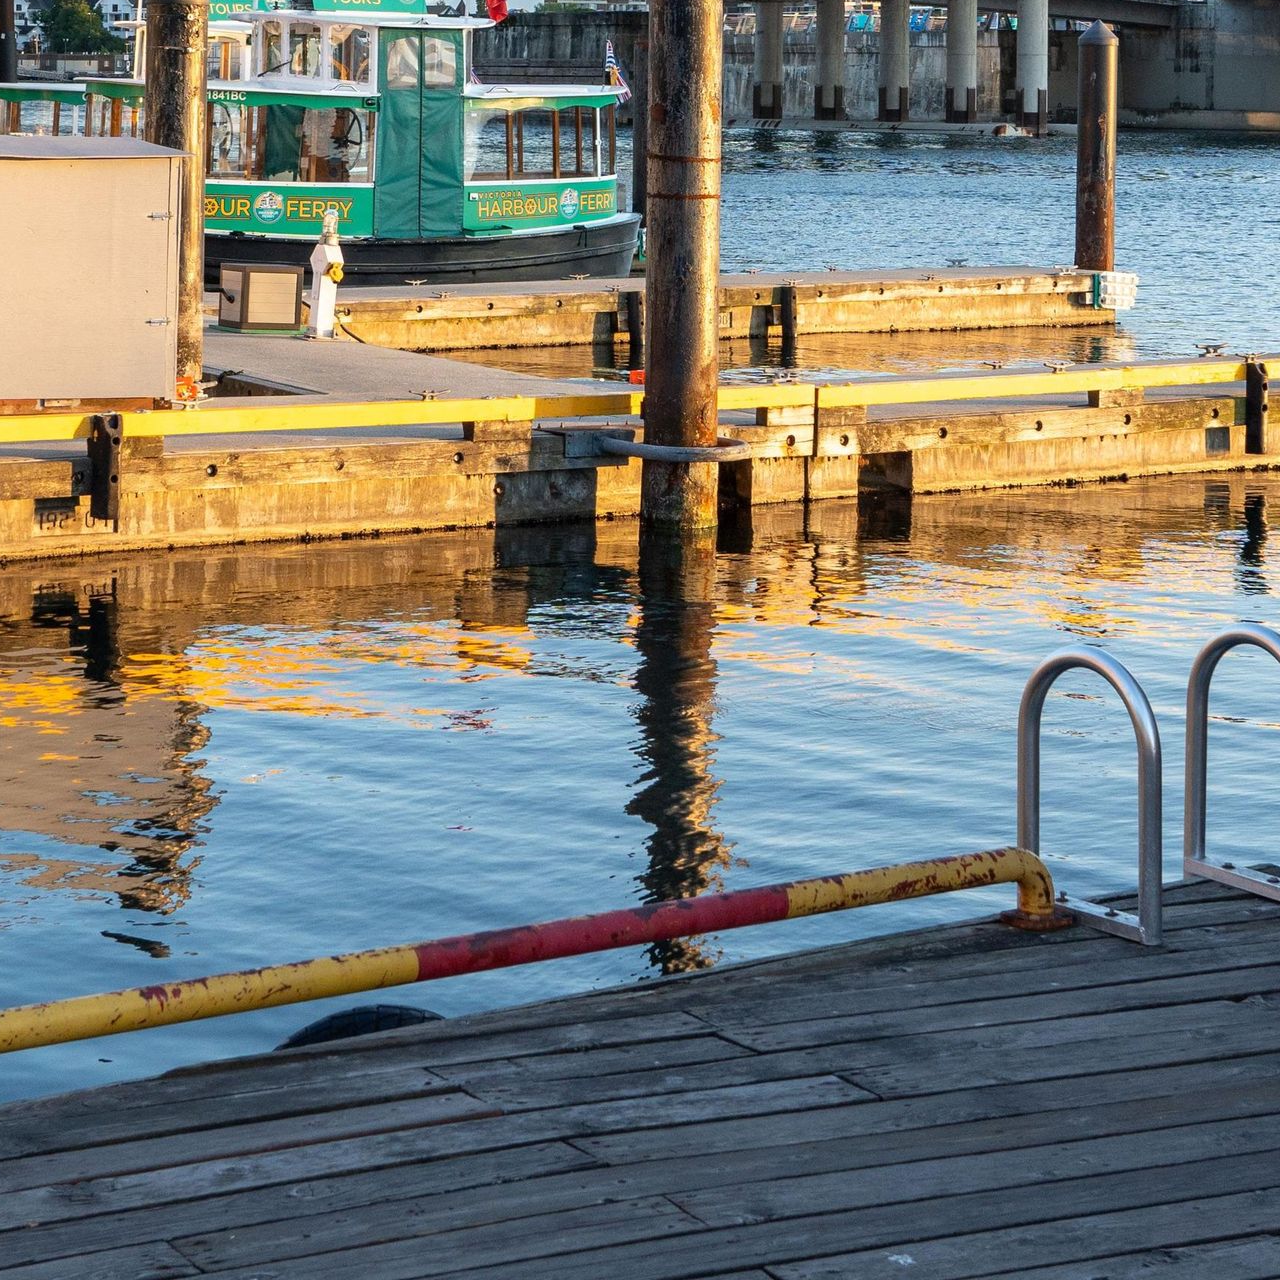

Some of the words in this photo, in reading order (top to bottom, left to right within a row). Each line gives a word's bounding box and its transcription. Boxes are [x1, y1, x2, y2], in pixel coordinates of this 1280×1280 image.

[209, 3, 253, 14] TOURS
[479, 191, 523, 199] VICTORIA
[478, 197, 558, 217] HARBOUR
[580, 192, 615, 210] FERRY
